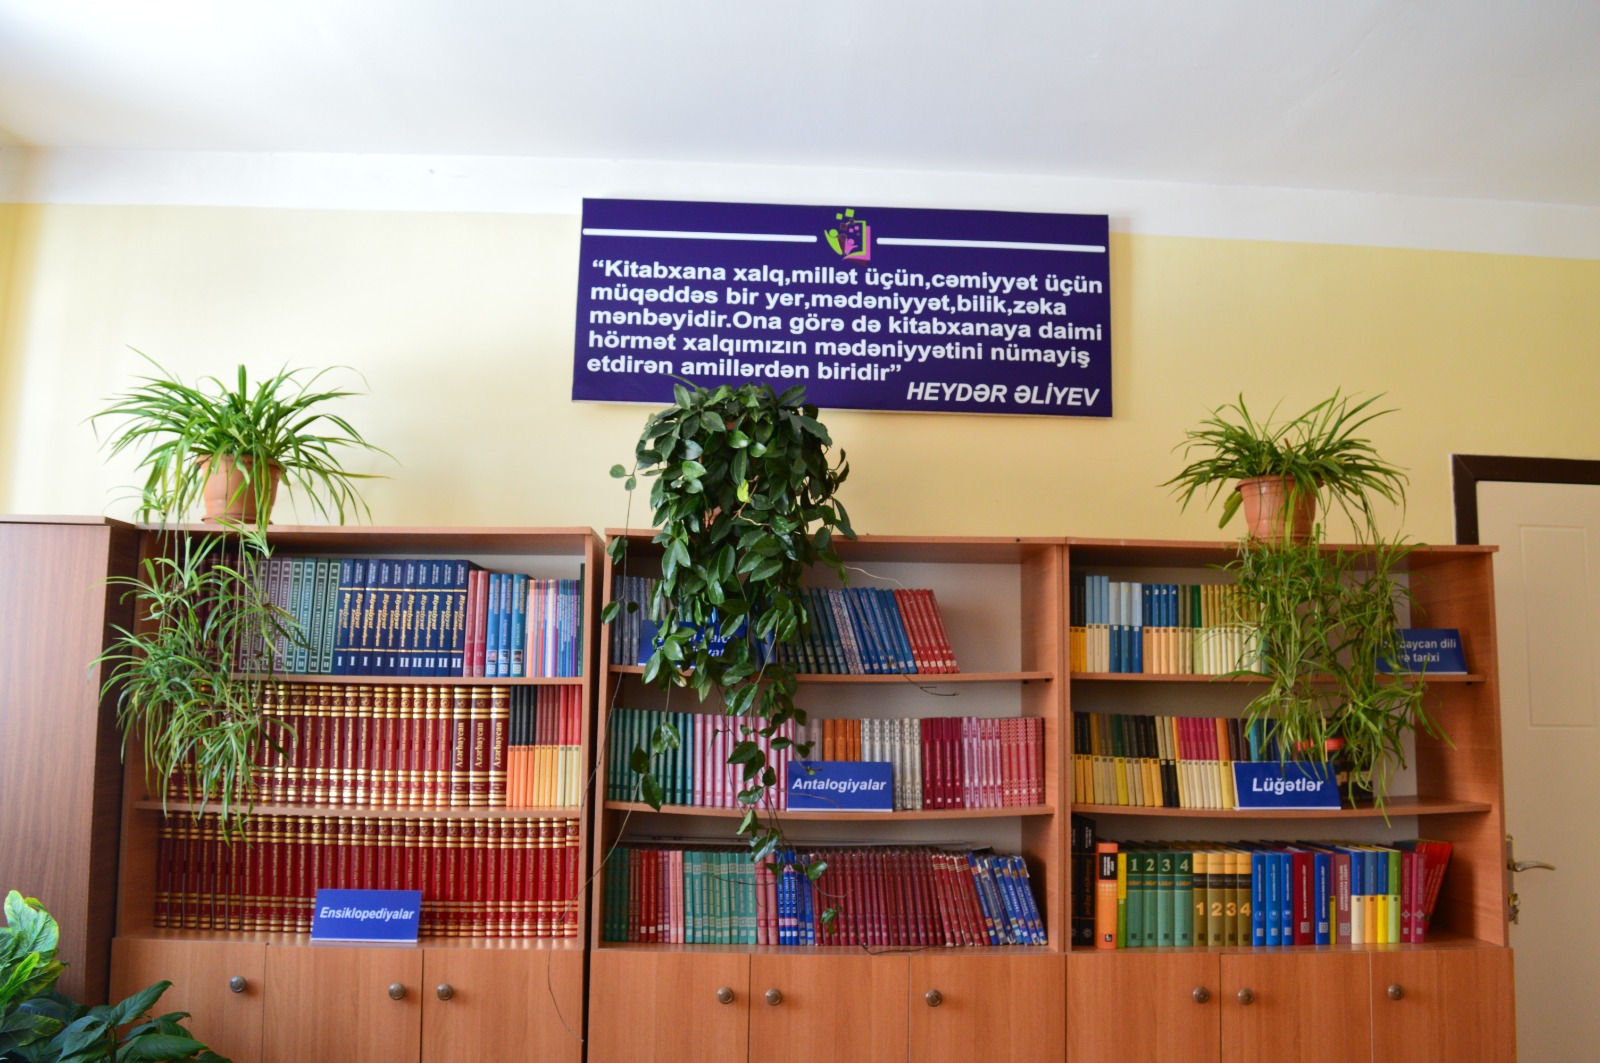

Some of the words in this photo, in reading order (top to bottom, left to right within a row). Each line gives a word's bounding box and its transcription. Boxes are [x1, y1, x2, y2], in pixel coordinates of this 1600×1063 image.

[732, 264, 858, 287] xalq,millət
[864, 267, 1039, 294] üçün,cəmiyyət
[1045, 273, 1103, 297] üçün
[590, 282, 719, 306] müqəddəs
[726, 286, 760, 306] bir
[589, 307, 782, 331] mənbəyidir.Ona
[789, 312, 845, 335] görə
[851, 314, 882, 333] də
[888, 315, 1032, 342] kitabxanaya
[1038, 321, 1102, 341] daimi
[588, 329, 677, 351] hörmət
[682, 333, 807, 357] xalqımızın
[814, 338, 983, 363] mədəniyyətini
[990, 343, 1091, 369] nümayiş
[586, 354, 673, 375] etdirən
[680, 358, 810, 379] amillərdən
[906, 381, 1008, 403] HEYDƏR
[1013, 382, 1100, 407] ƏLİYEV
[1440, 639, 1456, 649] dili
[456, 722, 465, 768] Azərbaycan
[475, 722, 485, 768] Azərbaycan
[494, 722, 503, 768] Azərbaycan
[792, 778, 887, 793] Antalogiyalar
[1252, 778, 1324, 795] Lüğətlər
[1131, 858, 1138, 871] 1
[1146, 859, 1155, 871] 2
[1162, 859, 1171, 872] 3
[1180, 859, 1189, 871] 4
[320, 906, 415, 922] Ensiklopediyalar
[1196, 902, 1204, 916] 1
[1211, 902, 1223, 917] 2
[1226, 902, 1237, 917] 3
[1240, 902, 1251, 916] 4
